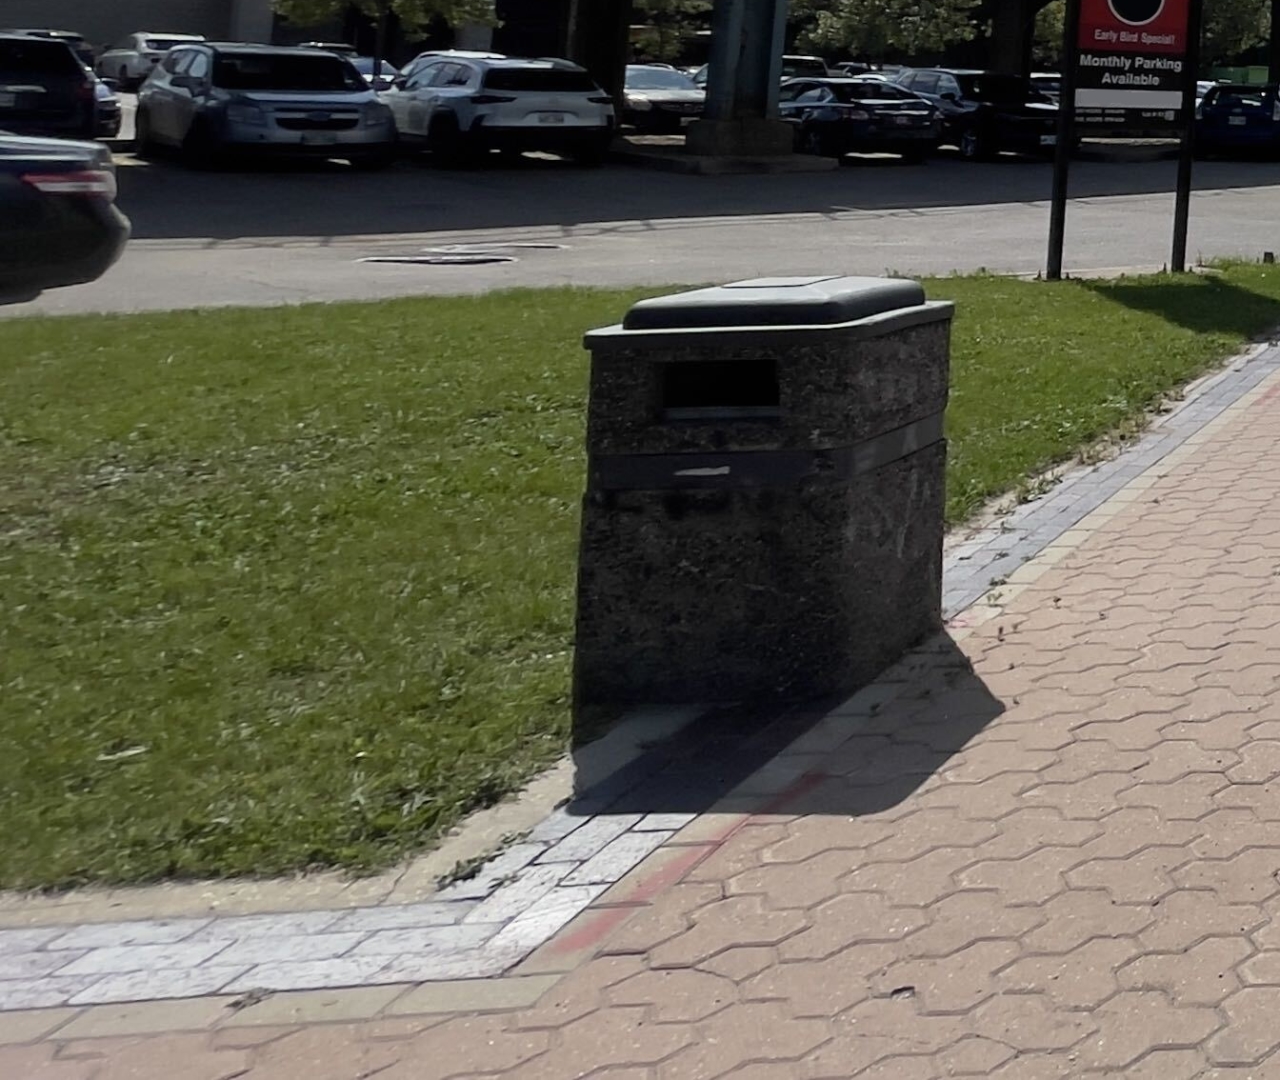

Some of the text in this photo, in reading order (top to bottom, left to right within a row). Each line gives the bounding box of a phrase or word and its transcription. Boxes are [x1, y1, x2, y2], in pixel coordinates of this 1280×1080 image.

[1094, 29, 1118, 43] Early
[1120, 31, 1138, 42] Bird
[1080, 54, 1182, 72] Monthly Parking
[1101, 72, 1160, 85] Available
